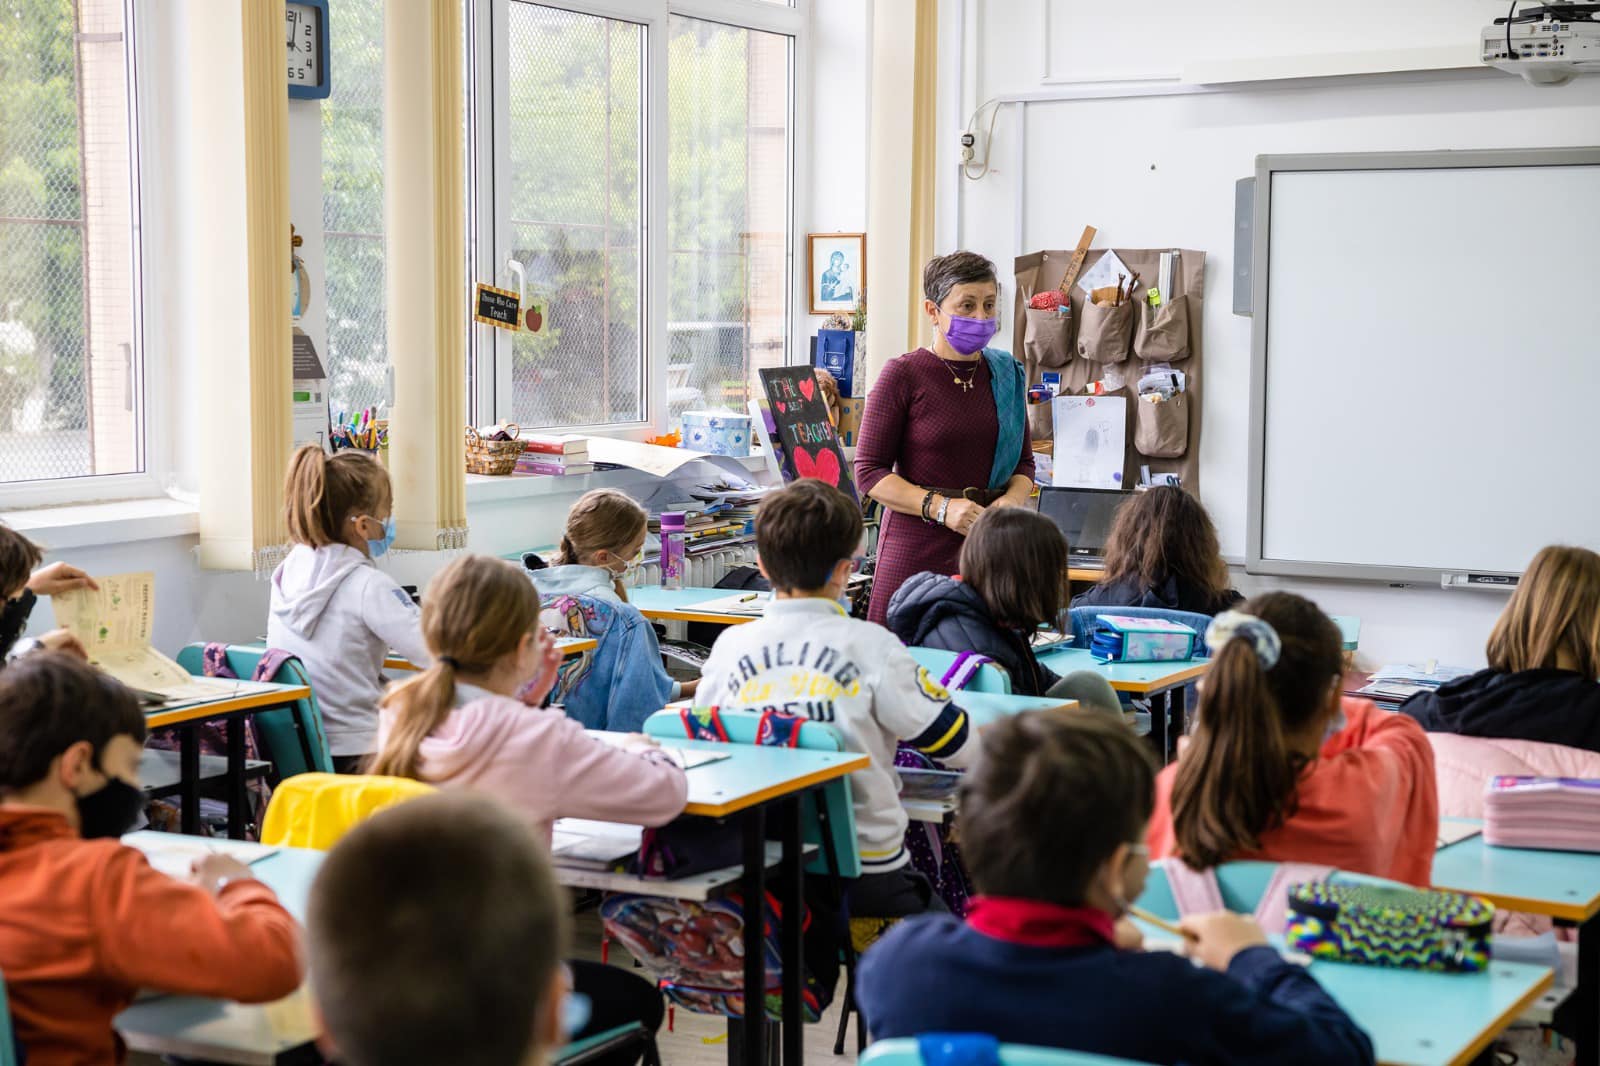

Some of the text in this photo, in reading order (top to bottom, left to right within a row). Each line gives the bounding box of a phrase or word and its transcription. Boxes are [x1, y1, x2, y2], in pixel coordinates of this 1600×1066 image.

[305, 25, 312, 36] 2
[305, 41, 312, 52] 3
[306, 58, 312, 69] 4
[288, 67, 295, 78] 6
[298, 68, 304, 79] 5
[490, 306, 507, 320] Teach
[769, 377, 796, 398] THE
[728, 642, 860, 695] SAILING
